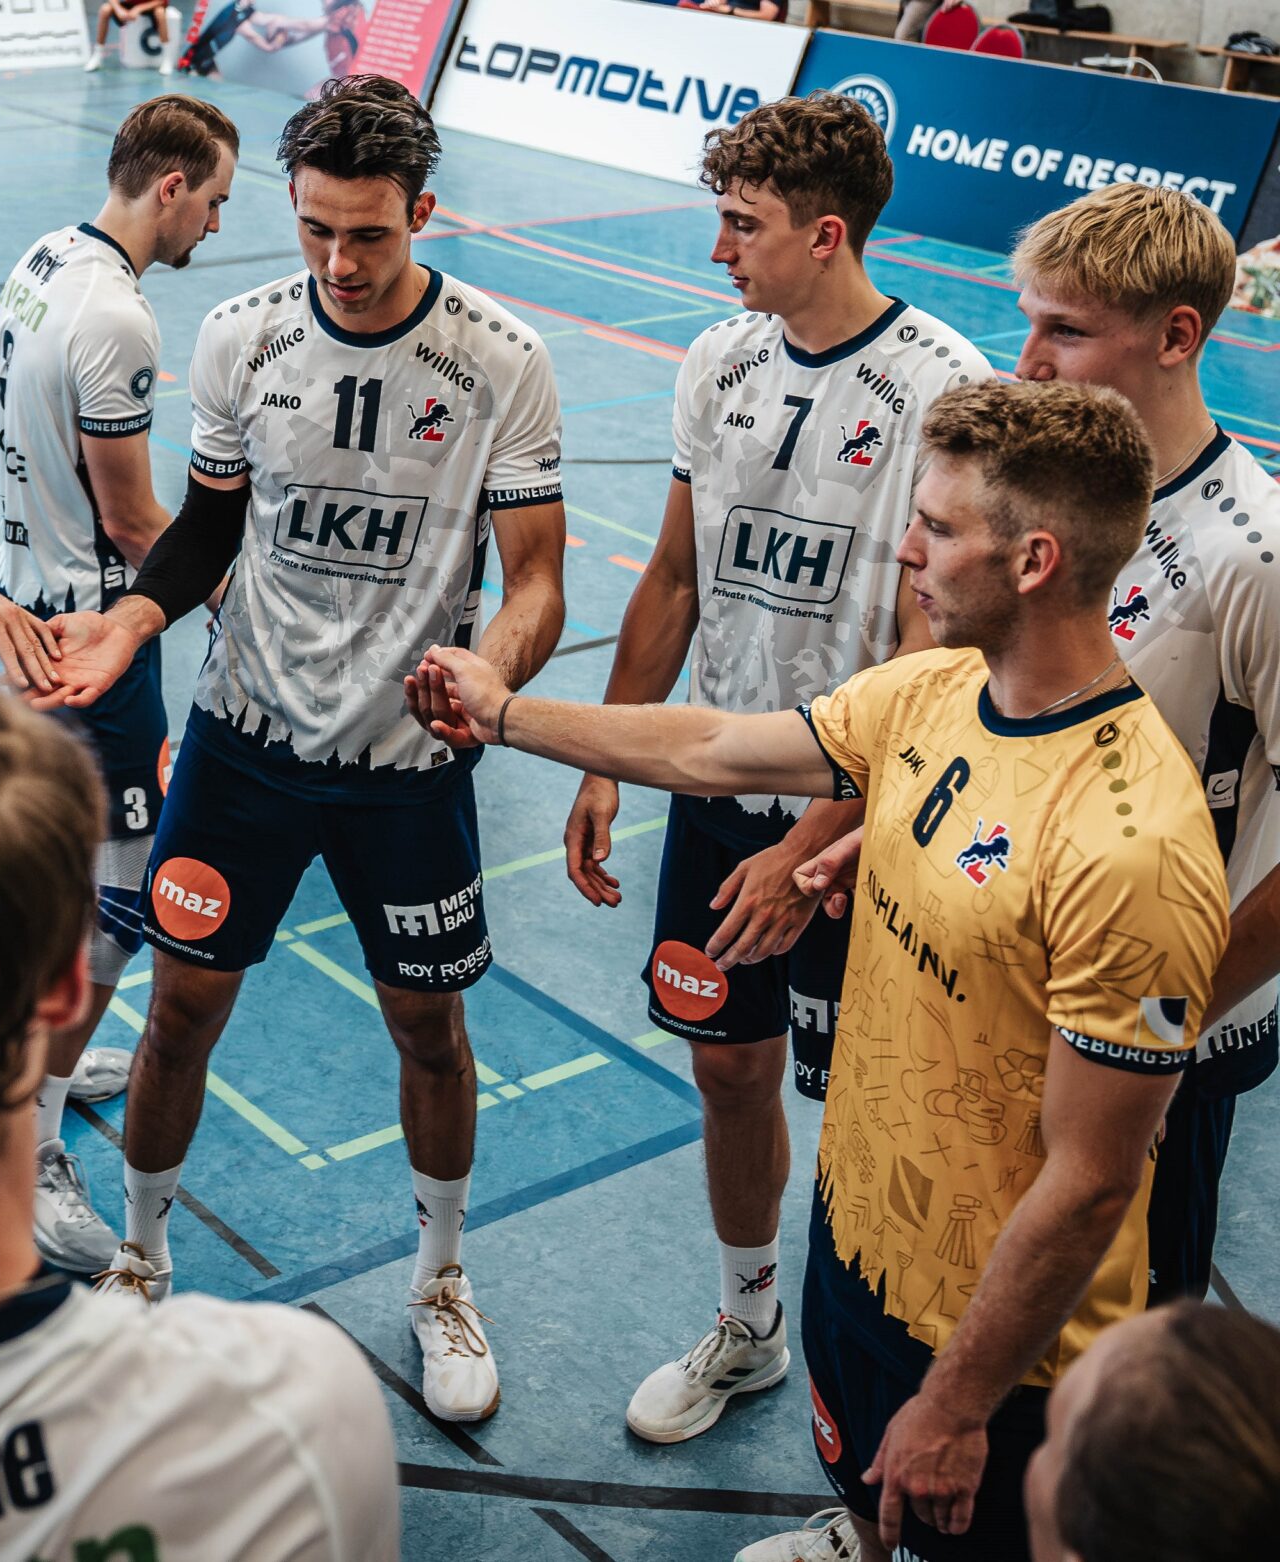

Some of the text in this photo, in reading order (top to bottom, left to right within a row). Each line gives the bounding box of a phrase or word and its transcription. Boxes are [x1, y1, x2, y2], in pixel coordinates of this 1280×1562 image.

[906, 124, 1237, 212] HOME OF RESPECT
[247, 326, 305, 373] willke
[415, 341, 476, 393] willke
[260, 392, 302, 410] JAKO
[332, 374, 383, 453] 11
[723, 411, 756, 430] AKO
[771, 394, 814, 471] 7
[288, 499, 408, 556] LKH
[270, 551, 407, 587] Private Krankenversicherung
[732, 522, 835, 588] LKH
[712, 586, 746, 601] Private
[123, 786, 149, 831] 3
[912, 756, 970, 848] 6
[157, 876, 222, 919] maz
[443, 902, 475, 932] BAU
[142, 922, 215, 960] ein-autozentrum.de
[398, 961, 434, 977] ROY
[656, 960, 719, 998] maz
[650, 1006, 727, 1037] ein-autozentrum.de
